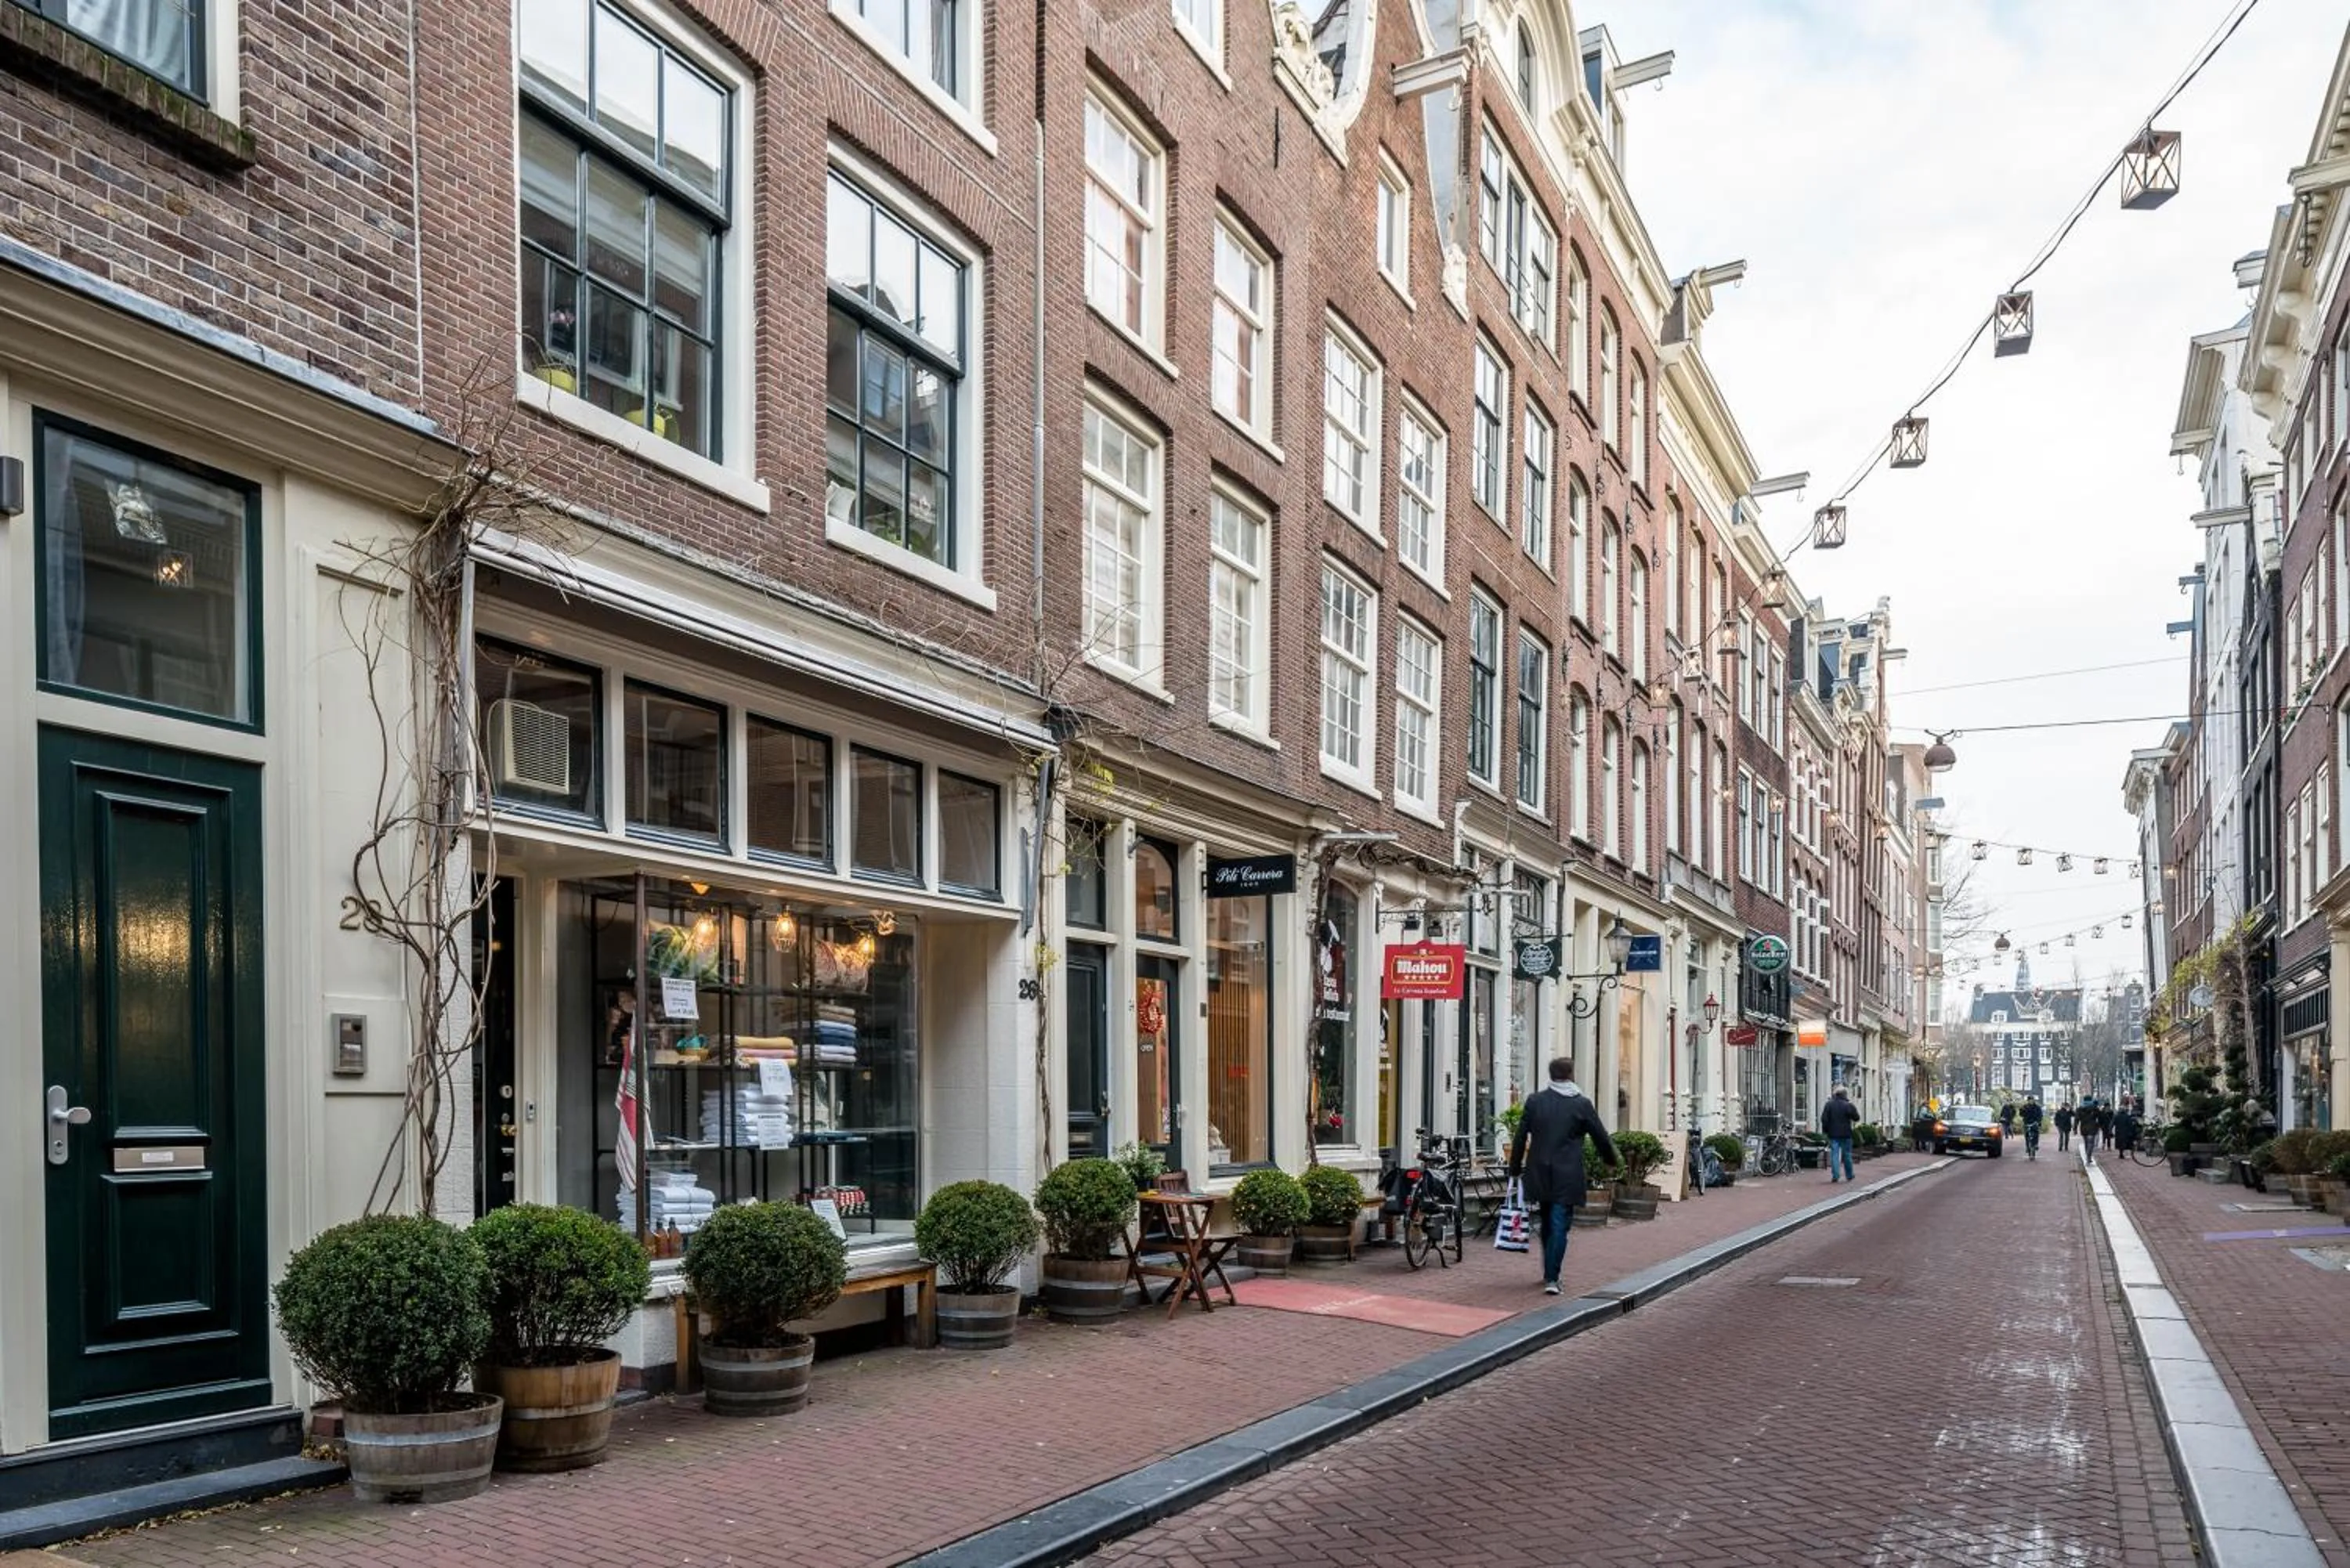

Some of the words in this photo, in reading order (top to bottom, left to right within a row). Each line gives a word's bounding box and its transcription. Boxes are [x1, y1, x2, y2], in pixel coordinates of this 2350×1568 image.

[1216, 867, 1238, 883] Pili
[1240, 865, 1283, 881] Carrera
[1397, 959, 1447, 974] Mahou
